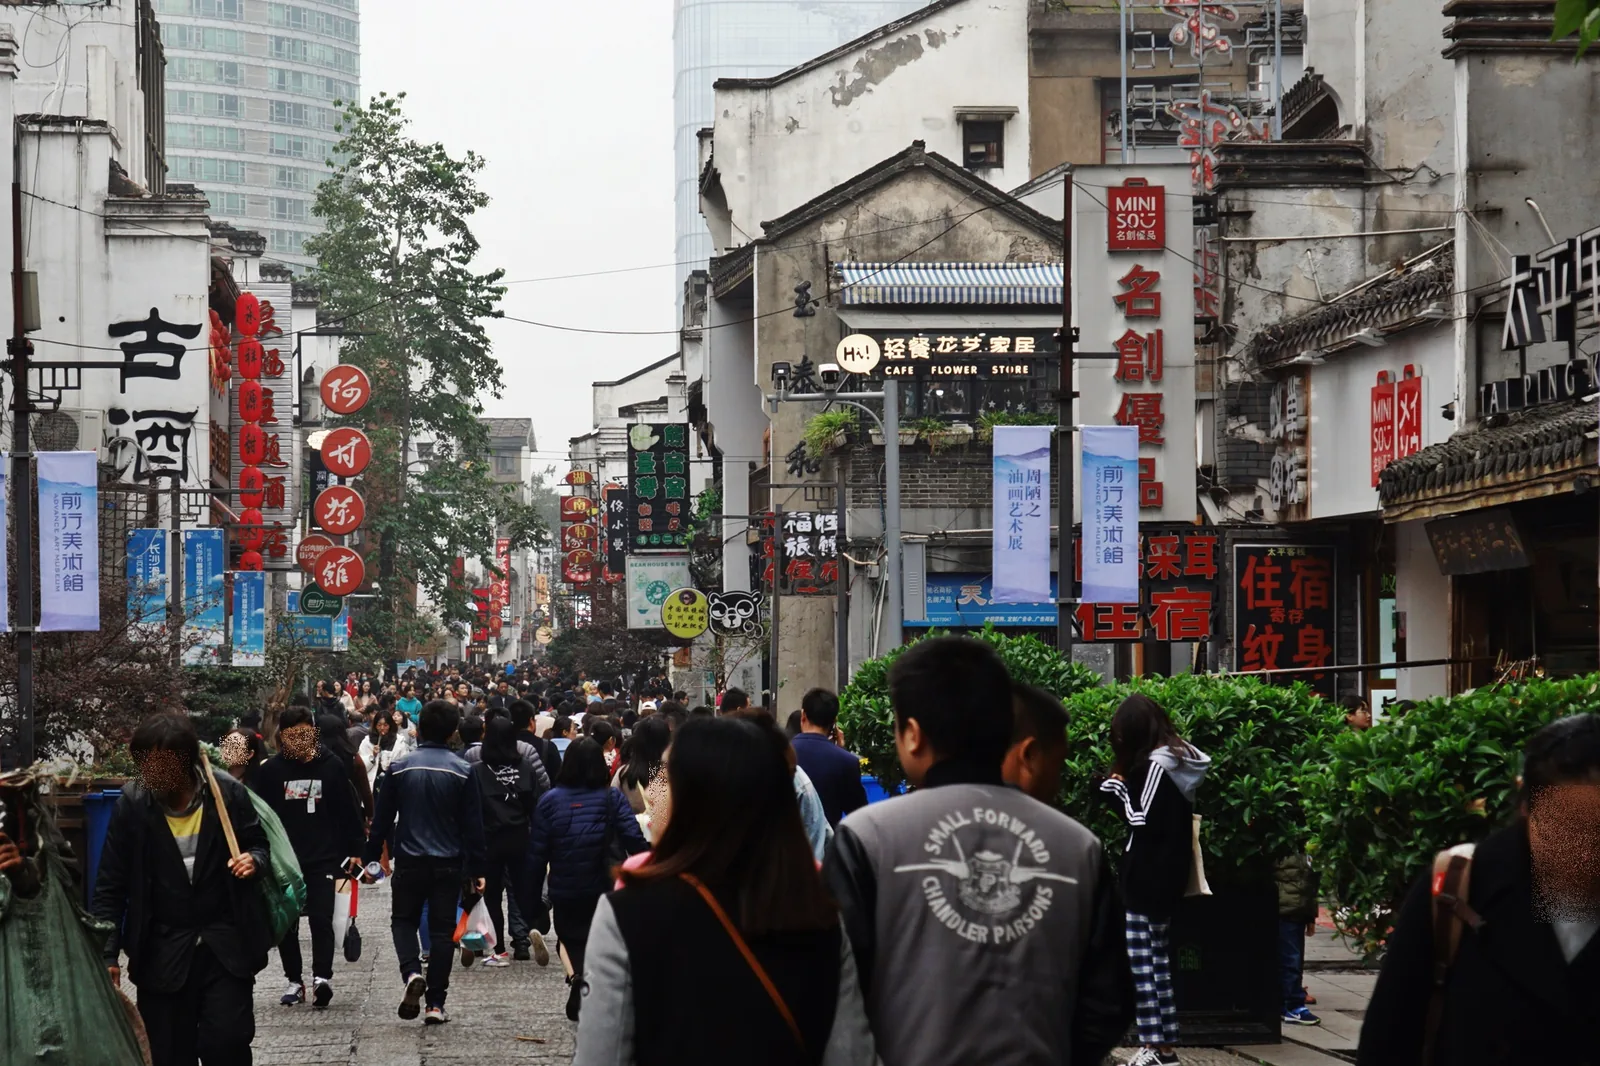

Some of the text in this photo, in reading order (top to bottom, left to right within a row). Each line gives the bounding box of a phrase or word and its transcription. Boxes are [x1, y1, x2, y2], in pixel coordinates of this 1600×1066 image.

[1116, 196, 1156, 211] MINI
[1116, 230, 1156, 241] 名創優品
[843, 346, 871, 362] Hi!
[884, 365, 1029, 375] CAFE FLOWER STORE
[1373, 396, 1392, 424] MINI
[572, 471, 589, 564] 湖南特产
[1008, 469, 1024, 550] 油画艺术展
[1102, 465, 1124, 564] 前行美術館
[61, 492, 84, 592] 前行美術館
[1075, 535, 1218, 582] 采耳
[1241, 554, 1330, 610] 住宿
[1075, 586, 1212, 641] 住宿
[1270, 607, 1305, 624] 寄存
[1241, 624, 1332, 671] 纹身
[924, 807, 1051, 864] SMALL FORWARD
[922, 876, 1053, 944] CHANDLER PARSONS
